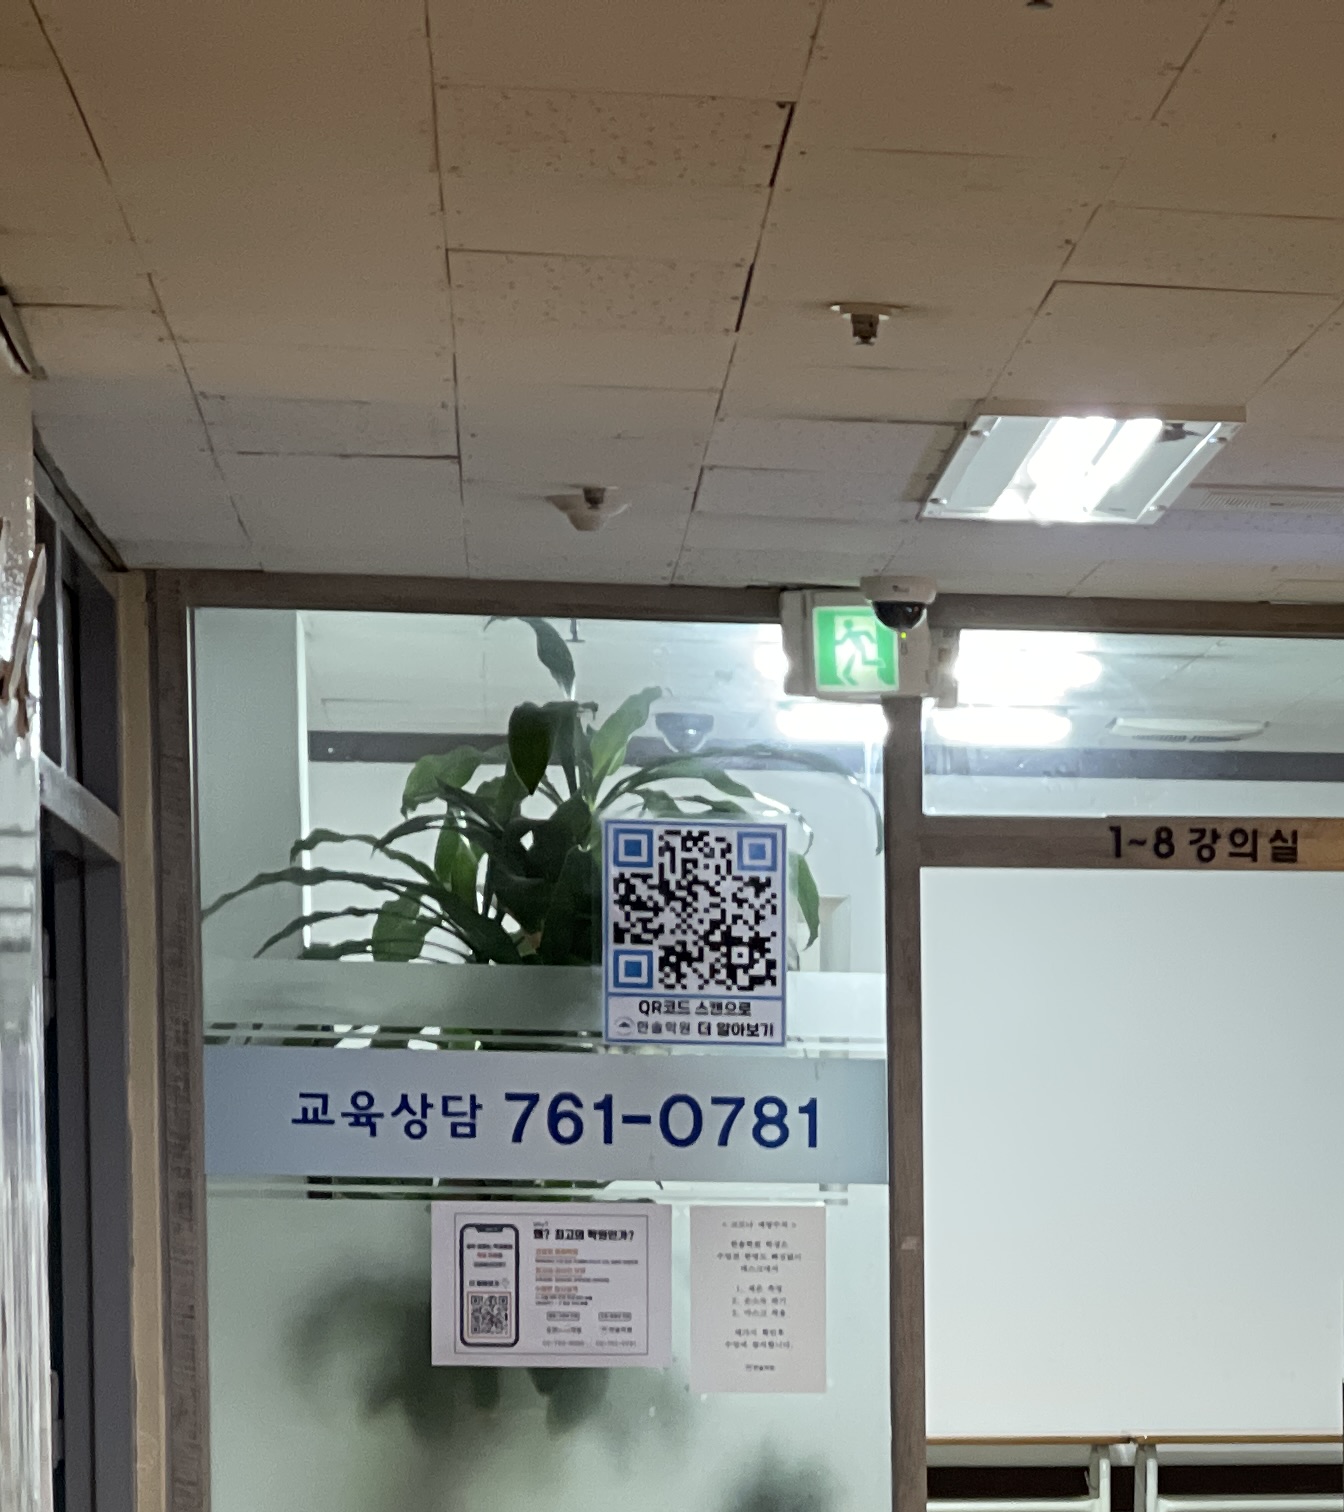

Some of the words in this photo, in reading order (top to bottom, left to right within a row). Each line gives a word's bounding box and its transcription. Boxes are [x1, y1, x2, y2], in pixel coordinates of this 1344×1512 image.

[1189, 827, 1299, 864] 강의실
[638, 1000, 691, 1016] QR코드
[695, 1000, 752, 1016] 스캔으로
[698, 1021, 711, 1036] 더
[716, 1022, 774, 1037] 알아보기
[292, 1090, 483, 1140] 교육상담
[504, 1091, 820, 1149] 761-0781
